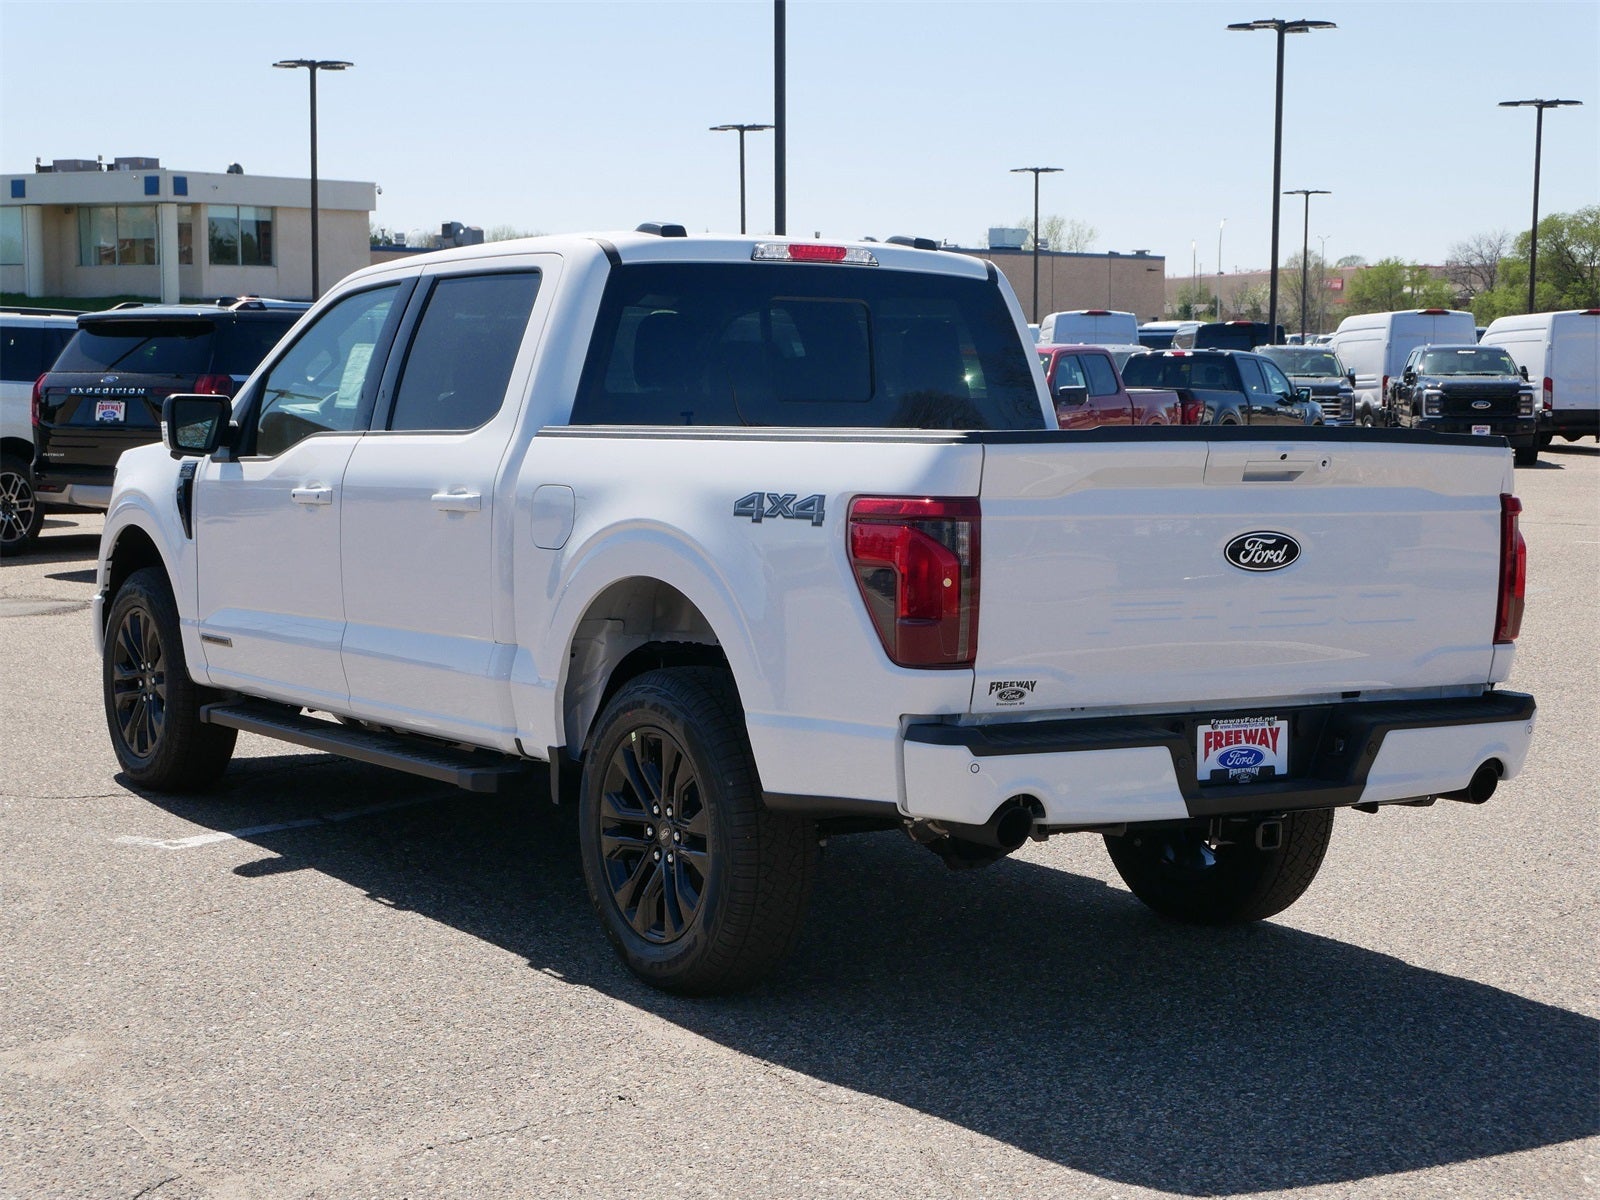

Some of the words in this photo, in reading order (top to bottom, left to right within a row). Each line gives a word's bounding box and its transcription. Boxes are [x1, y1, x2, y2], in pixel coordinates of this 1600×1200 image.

[1239, 537, 1288, 564] Ford
[988, 680, 1037, 696] FREEWAY
[1210, 715, 1278, 726] FreewayFord.net
[1204, 726, 1281, 763] FREEWAY
[1226, 750, 1256, 766] Ford
[1228, 766, 1260, 779] FREEWAY
